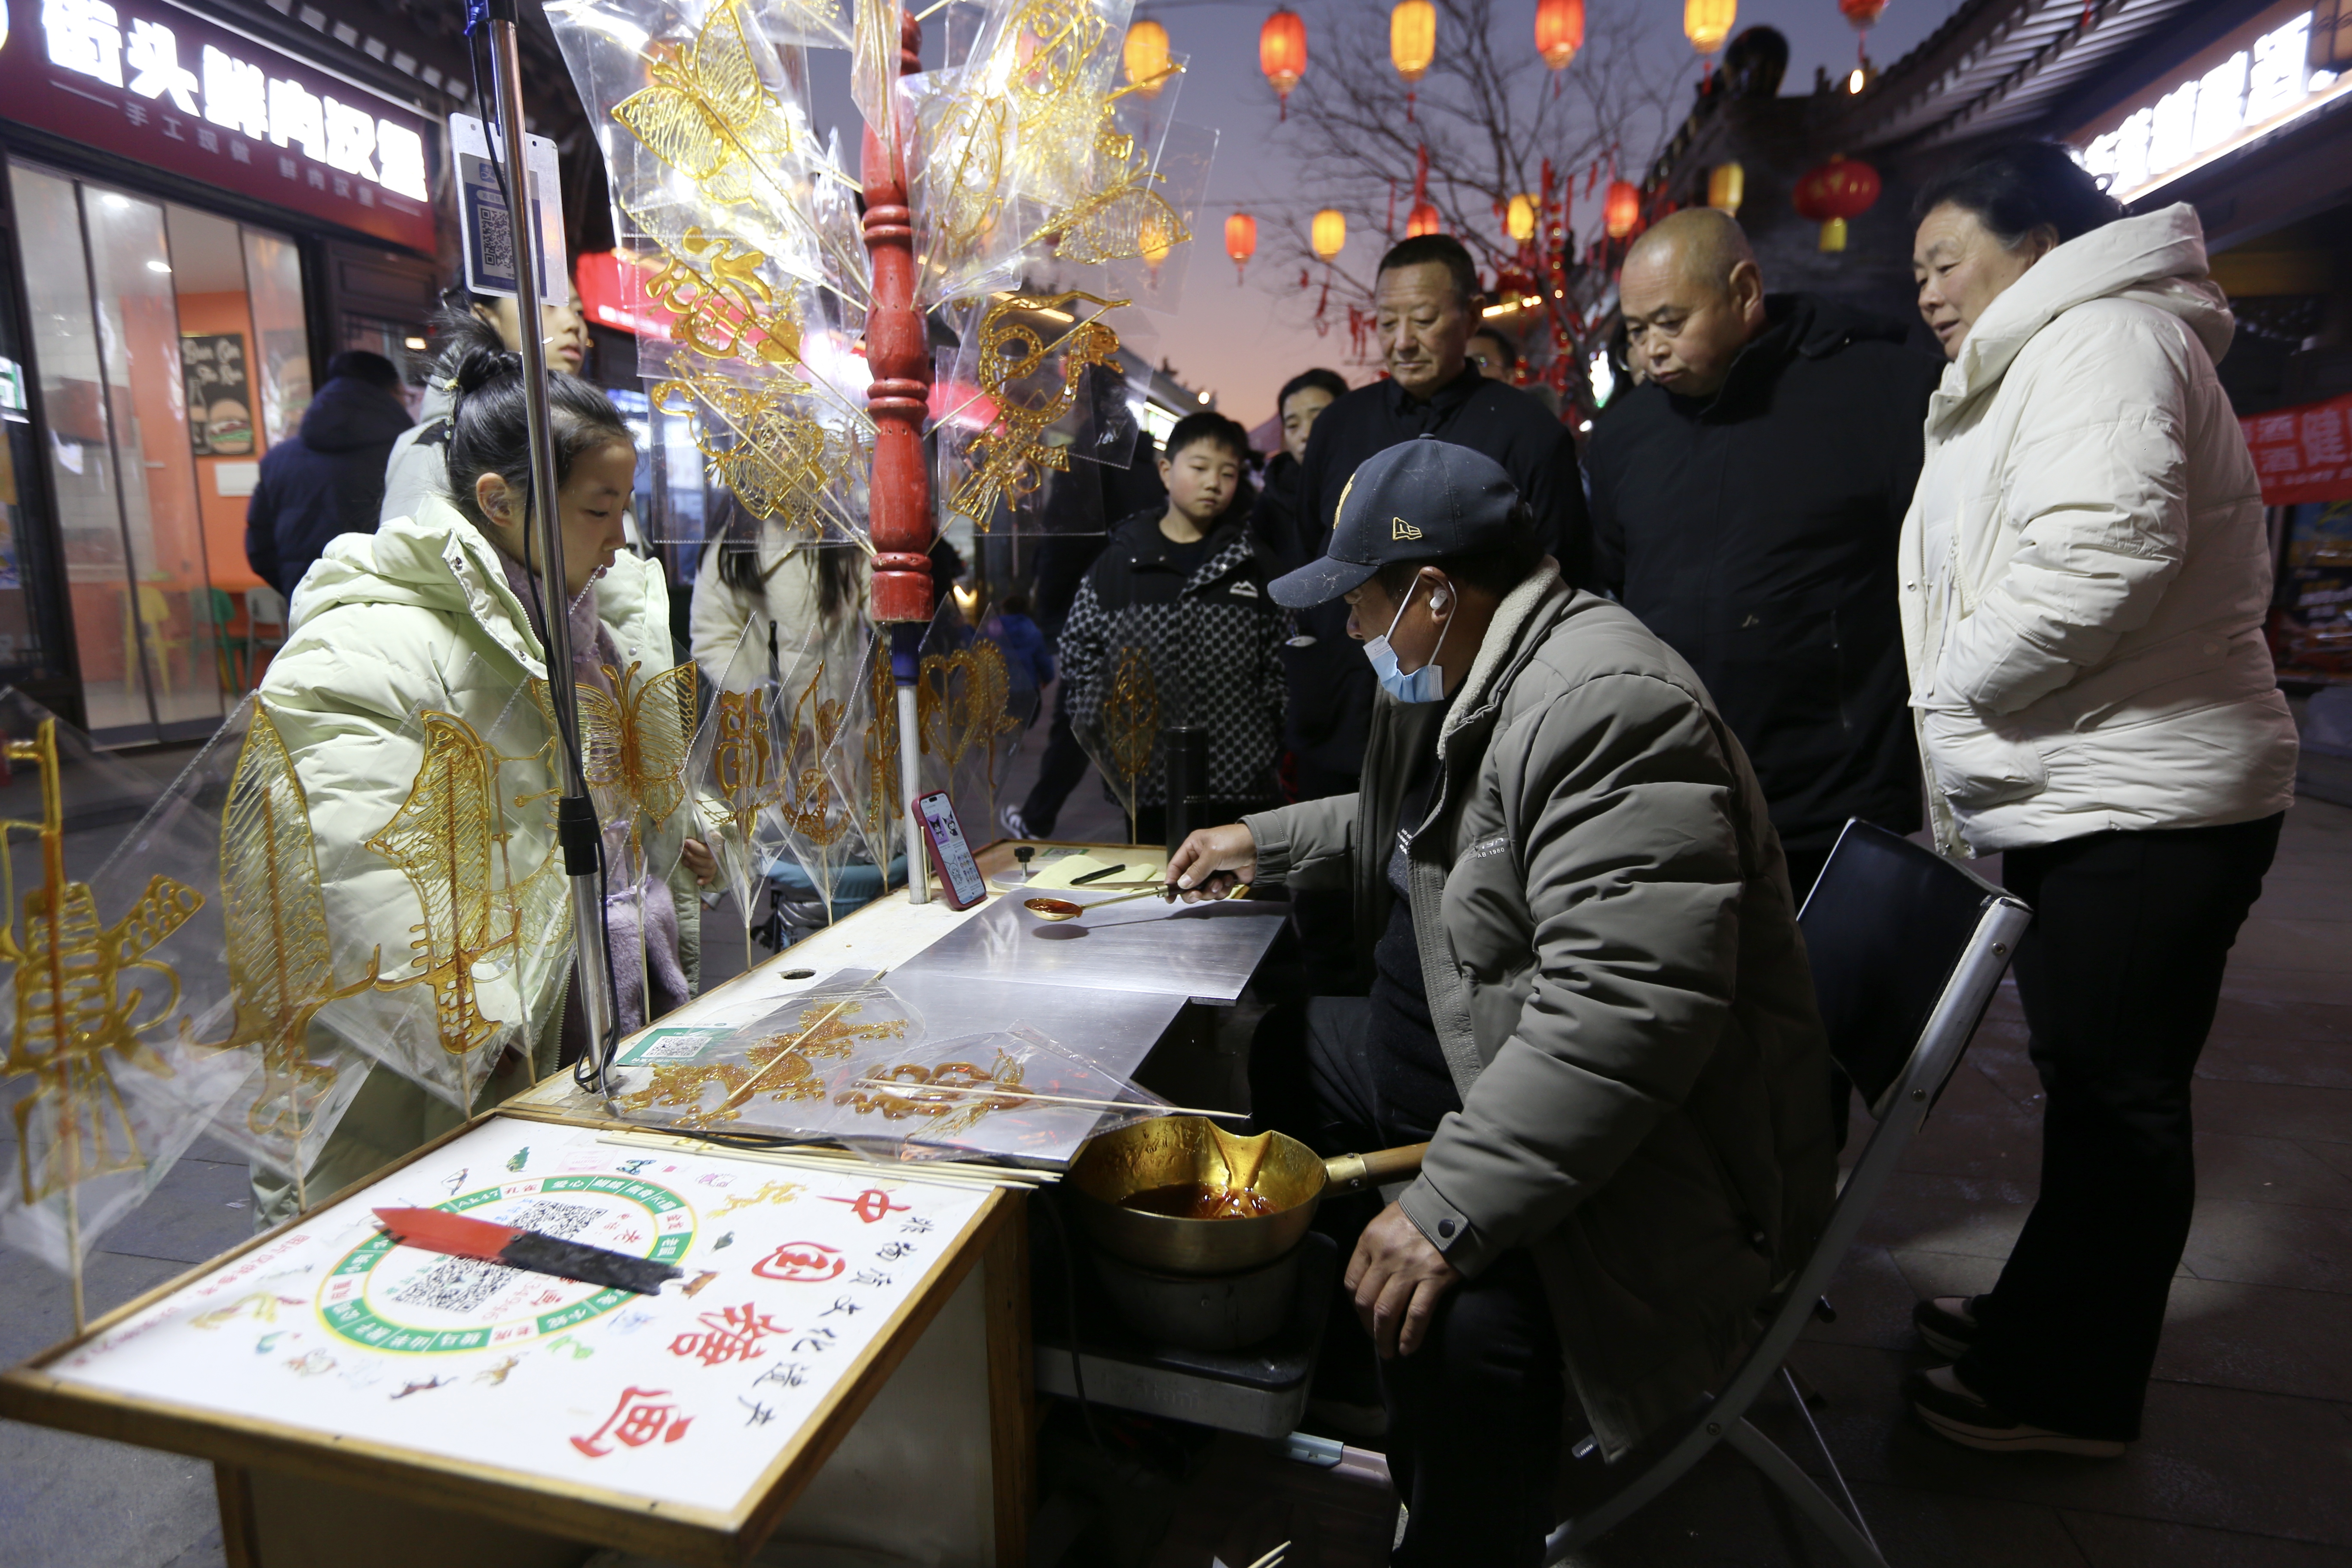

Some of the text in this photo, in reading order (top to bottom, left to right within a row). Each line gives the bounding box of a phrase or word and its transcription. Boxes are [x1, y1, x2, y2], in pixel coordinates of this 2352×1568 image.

[41, 0, 428, 202] 街头鲜肉汉堡
[569, 1189, 911, 1457] 中国糖画
